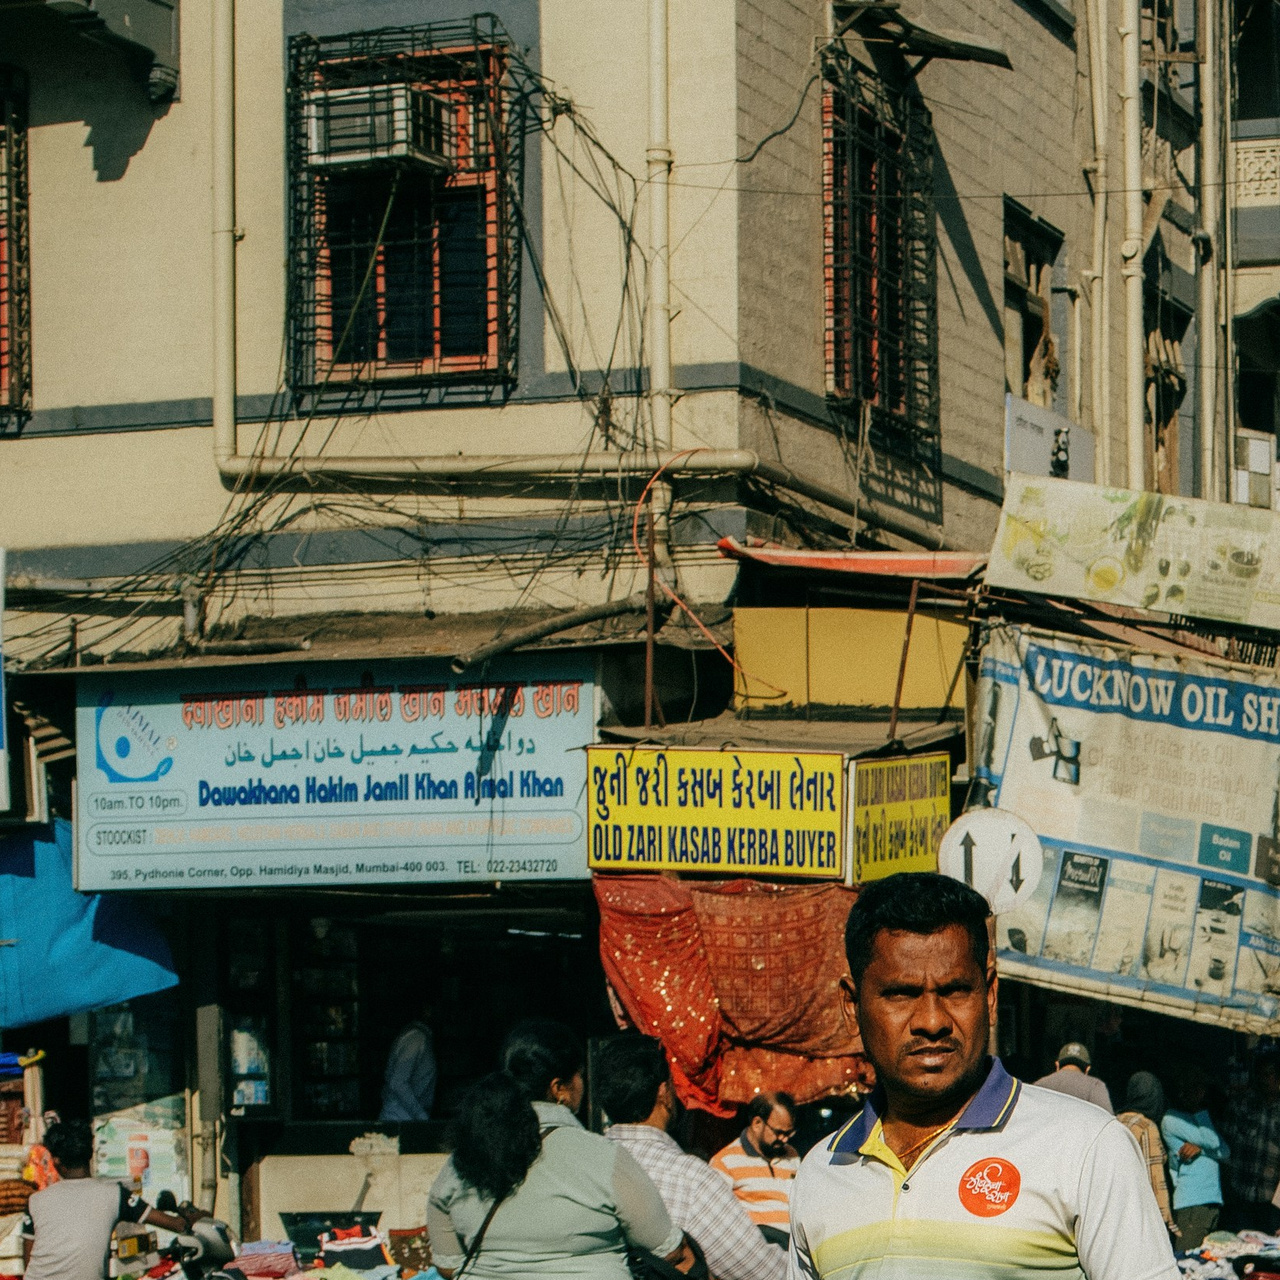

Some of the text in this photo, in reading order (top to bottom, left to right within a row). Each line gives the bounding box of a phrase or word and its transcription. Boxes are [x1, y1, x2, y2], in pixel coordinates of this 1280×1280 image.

[531, 679, 584, 719] खान
[1034, 654, 1176, 716] LUCKNOW
[1181, 682, 1235, 726] OIL
[198, 777, 300, 807] Dawakhana
[305, 775, 358, 804] Hakim
[364, 772, 409, 802] Jamil
[415, 772, 459, 800] Khan
[520, 769, 564, 798] Khan
[594, 752, 628, 821] જુની
[636, 753, 669, 807] જરી
[677, 767, 723, 808] કસબ
[789, 757, 836, 813] લેનાર
[593, 823, 622, 861] OLD
[627, 824, 662, 863] ZARI
[668, 825, 721, 864] KASAB
[727, 828, 780, 867] KERBA
[785, 830, 836, 869] BUYER
[134, 868, 185, 883] Pydhonie
[188, 867, 228, 880] Corner,
[259, 863, 310, 878] Hamidiya
[486, 859, 558, 873] 022-23432720
